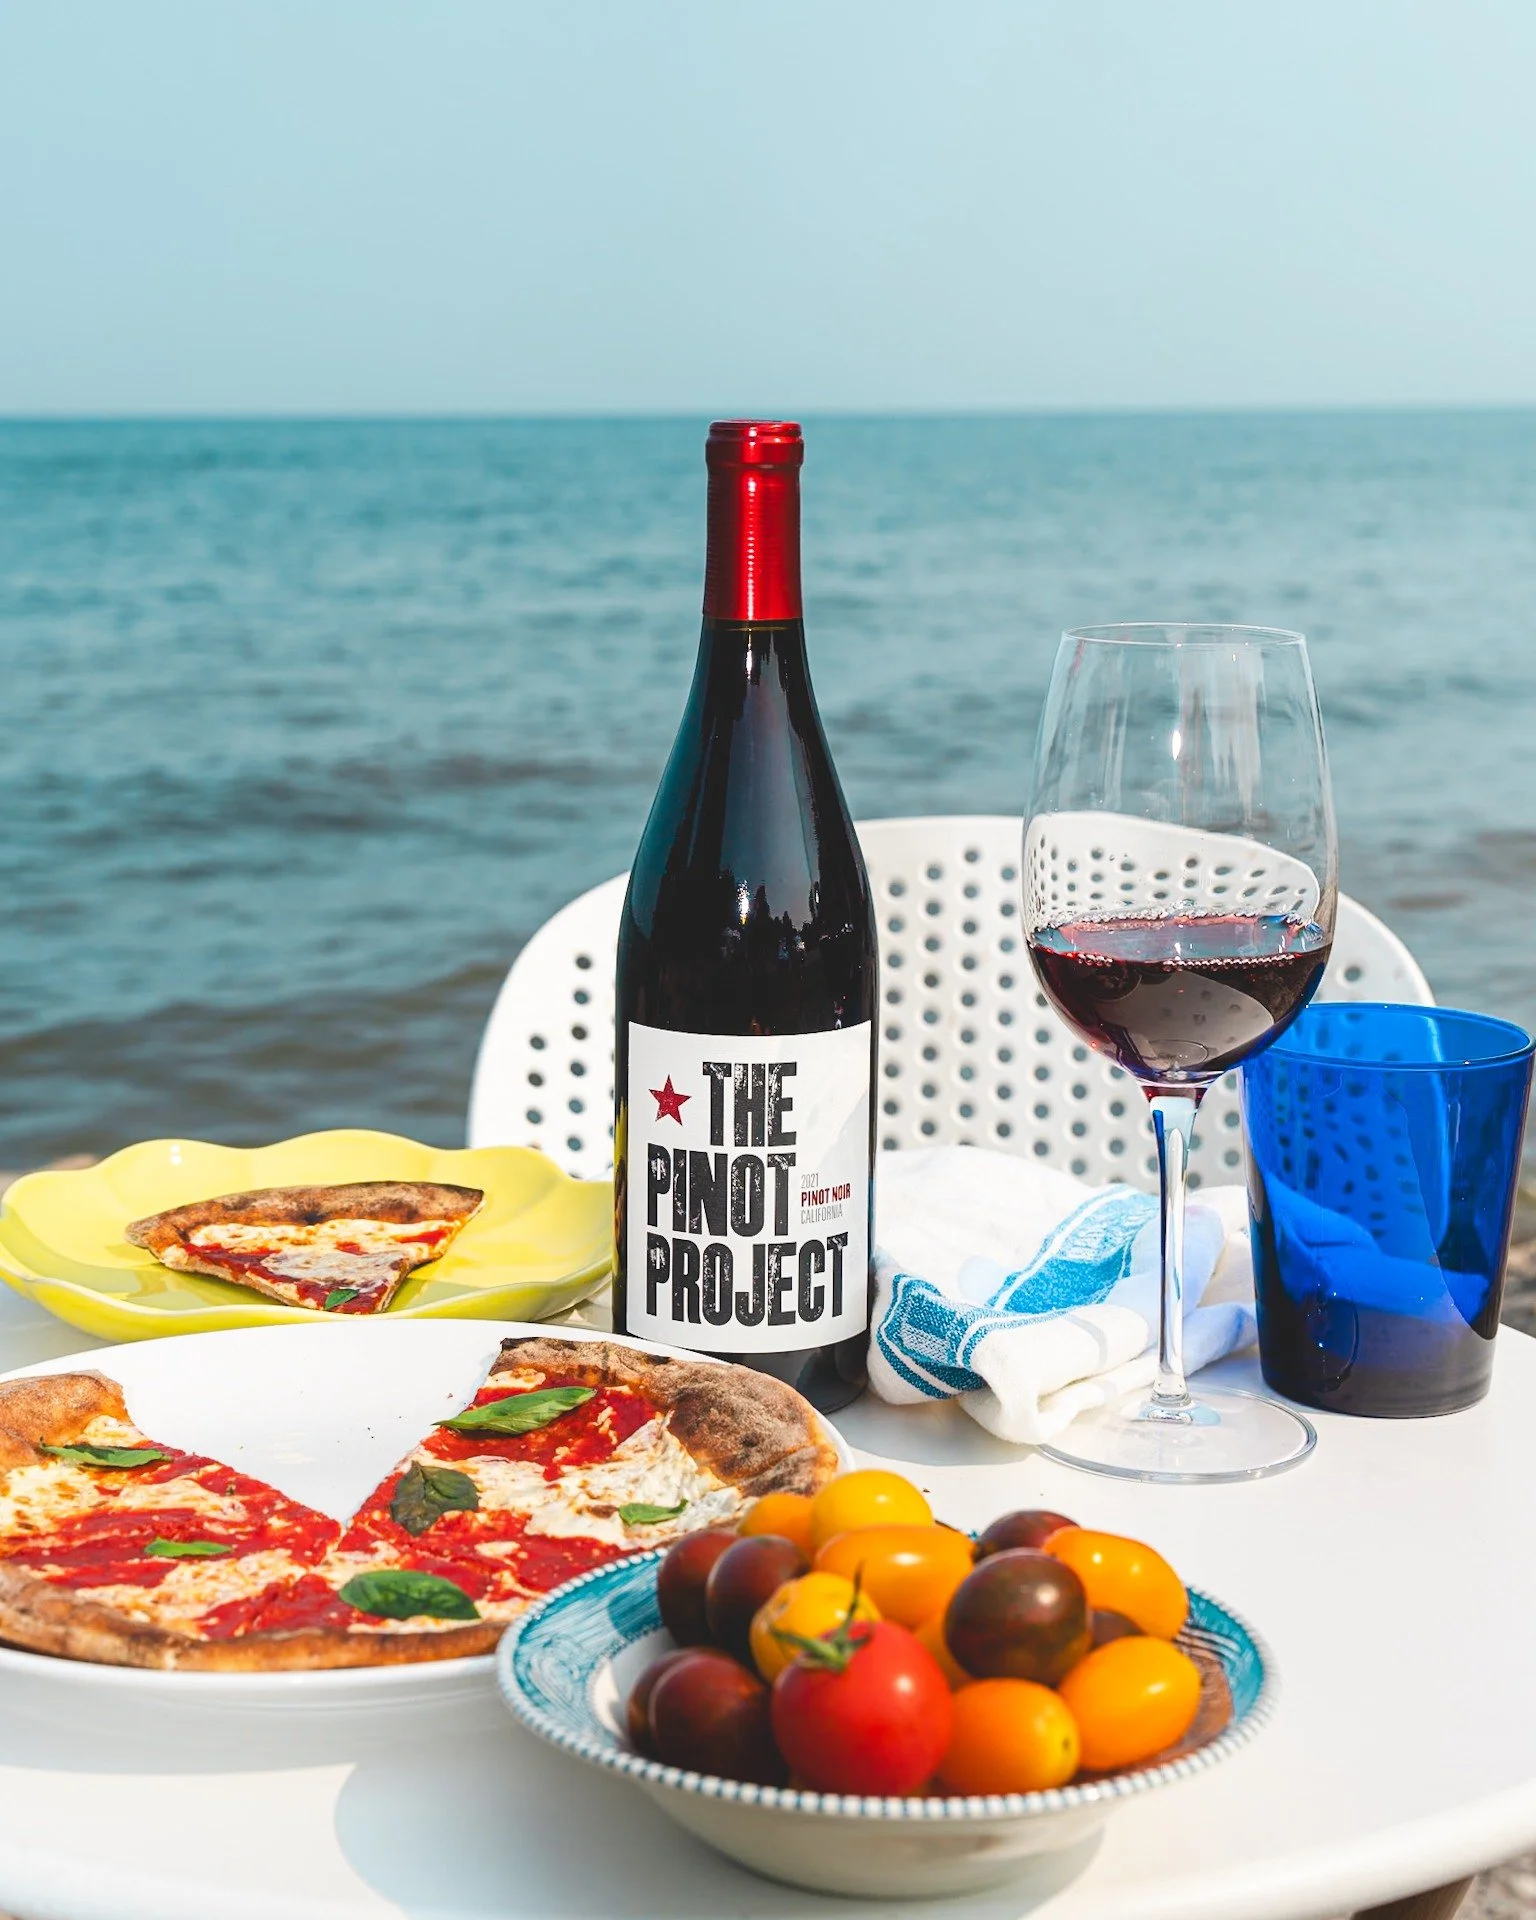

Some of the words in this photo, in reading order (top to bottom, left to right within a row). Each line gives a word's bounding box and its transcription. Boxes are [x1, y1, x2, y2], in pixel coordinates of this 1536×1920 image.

[702, 1061, 797, 1147] THE
[647, 1143, 796, 1237] PINOT
[801, 1173, 819, 1188] 2021
[801, 1188, 830, 1207] PINOT
[832, 1183, 851, 1202] NOIR
[801, 1204, 843, 1224] CALIFORNIA
[646, 1231, 849, 1326] PROJECT
